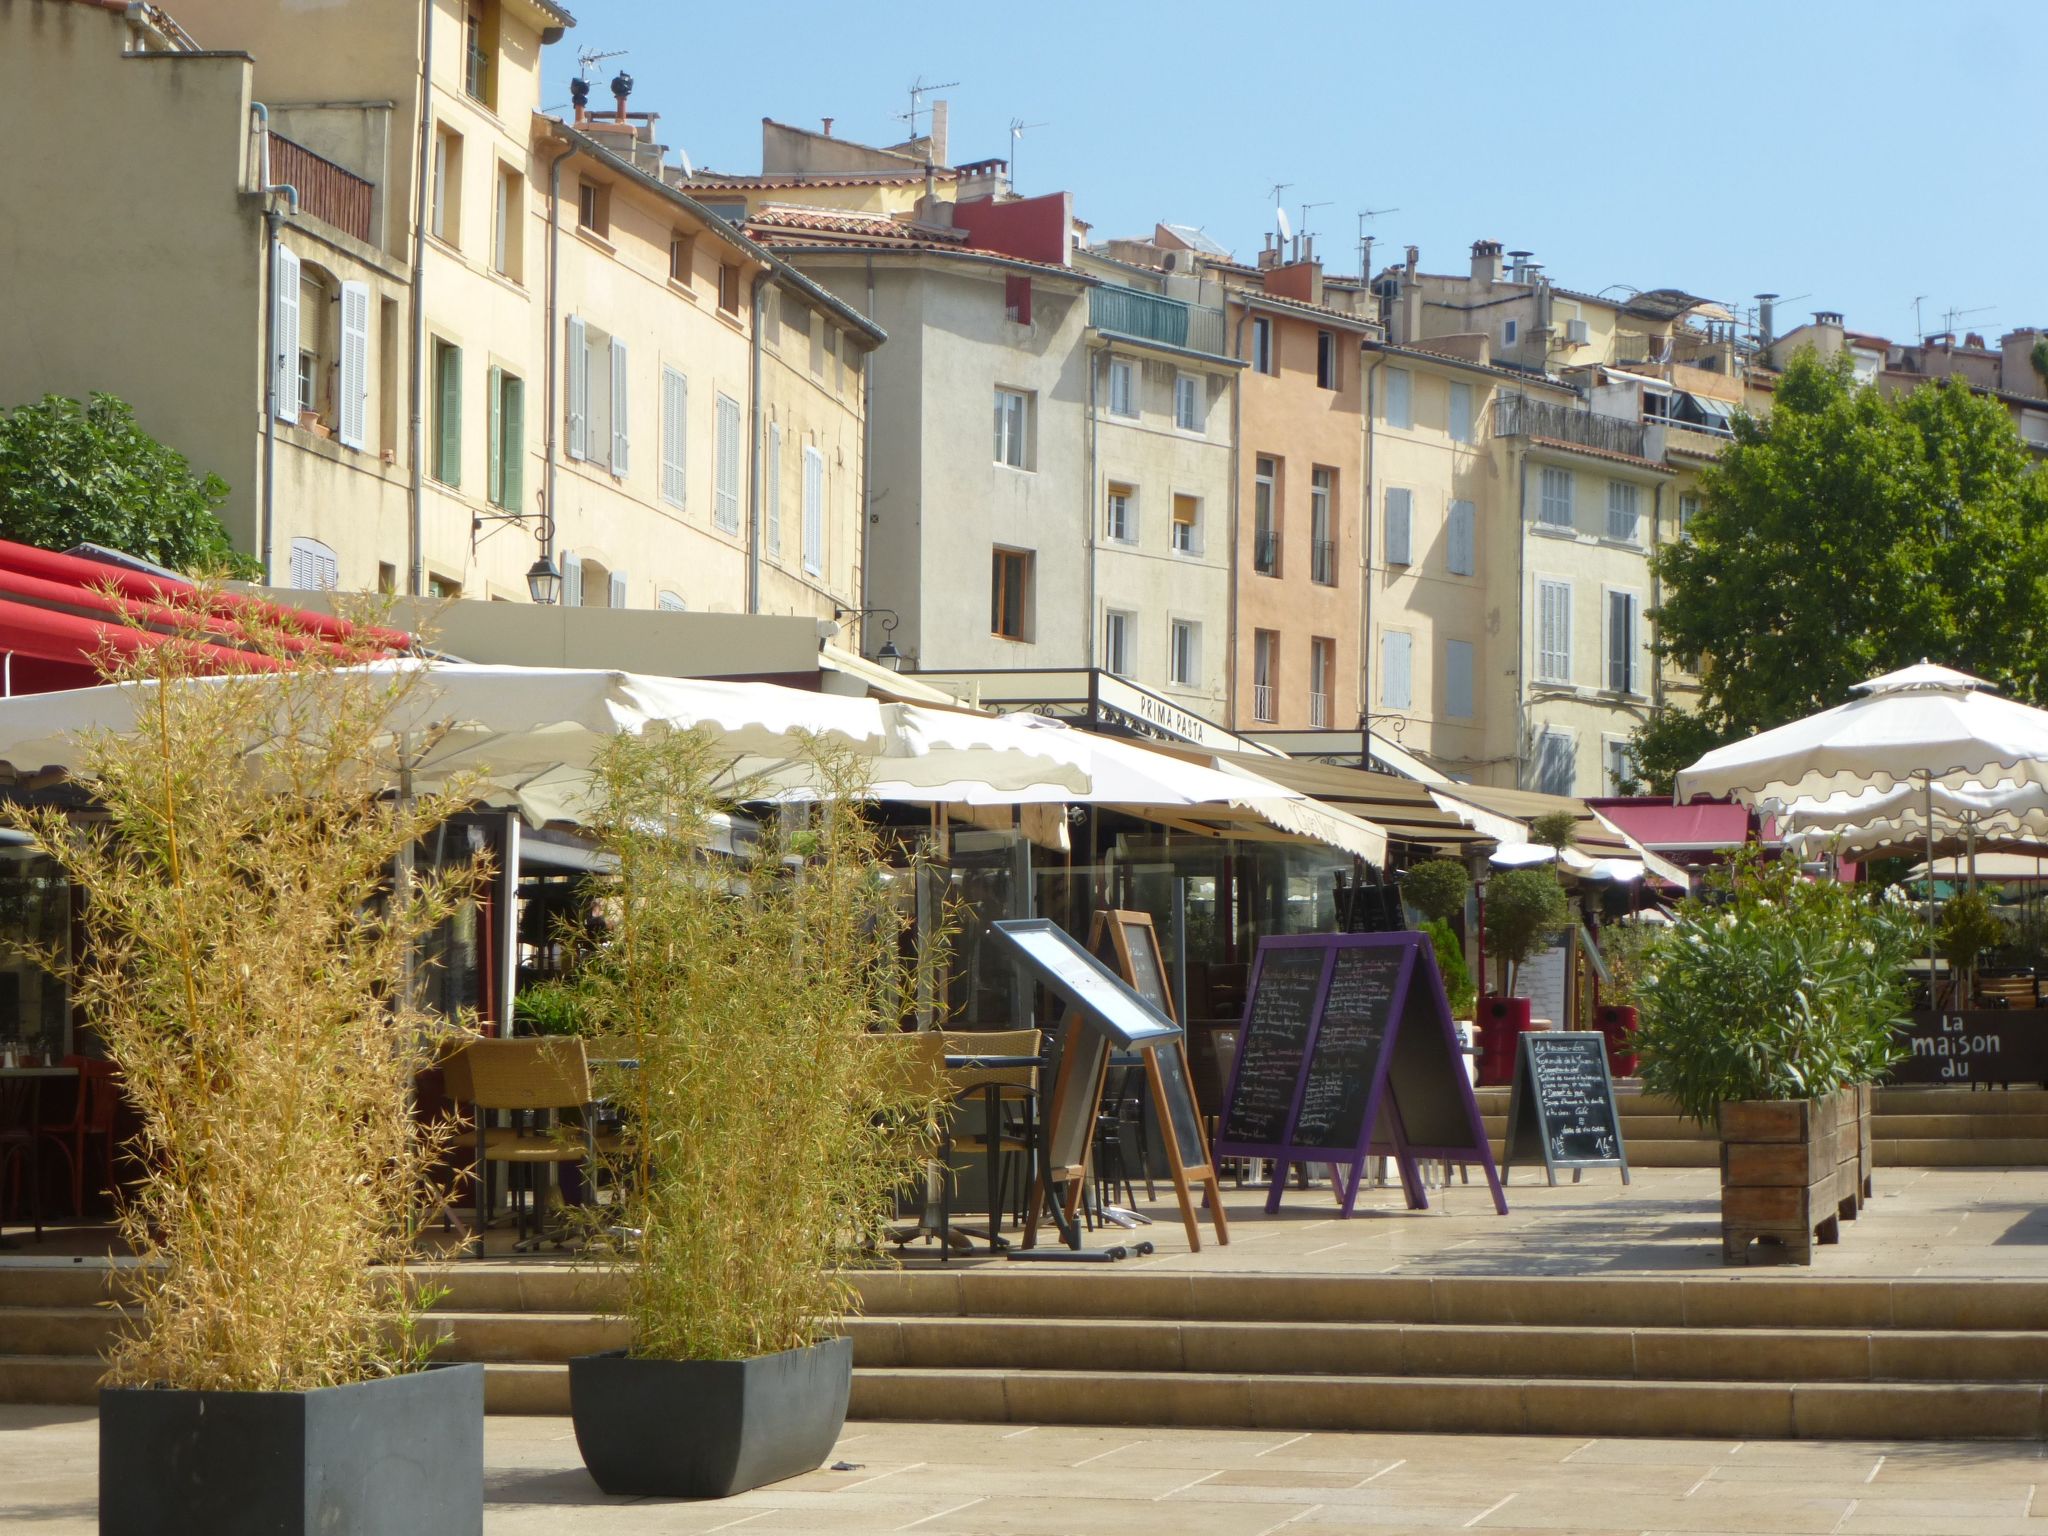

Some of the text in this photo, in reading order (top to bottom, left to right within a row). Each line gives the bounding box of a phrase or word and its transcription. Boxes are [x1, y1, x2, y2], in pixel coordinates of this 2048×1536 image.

[1140, 696, 1204, 743] PRIMA PASTA
[1943, 1015, 1963, 1031] La
[1912, 1034, 2000, 1056] maison
[1941, 1058, 1969, 1077] du
